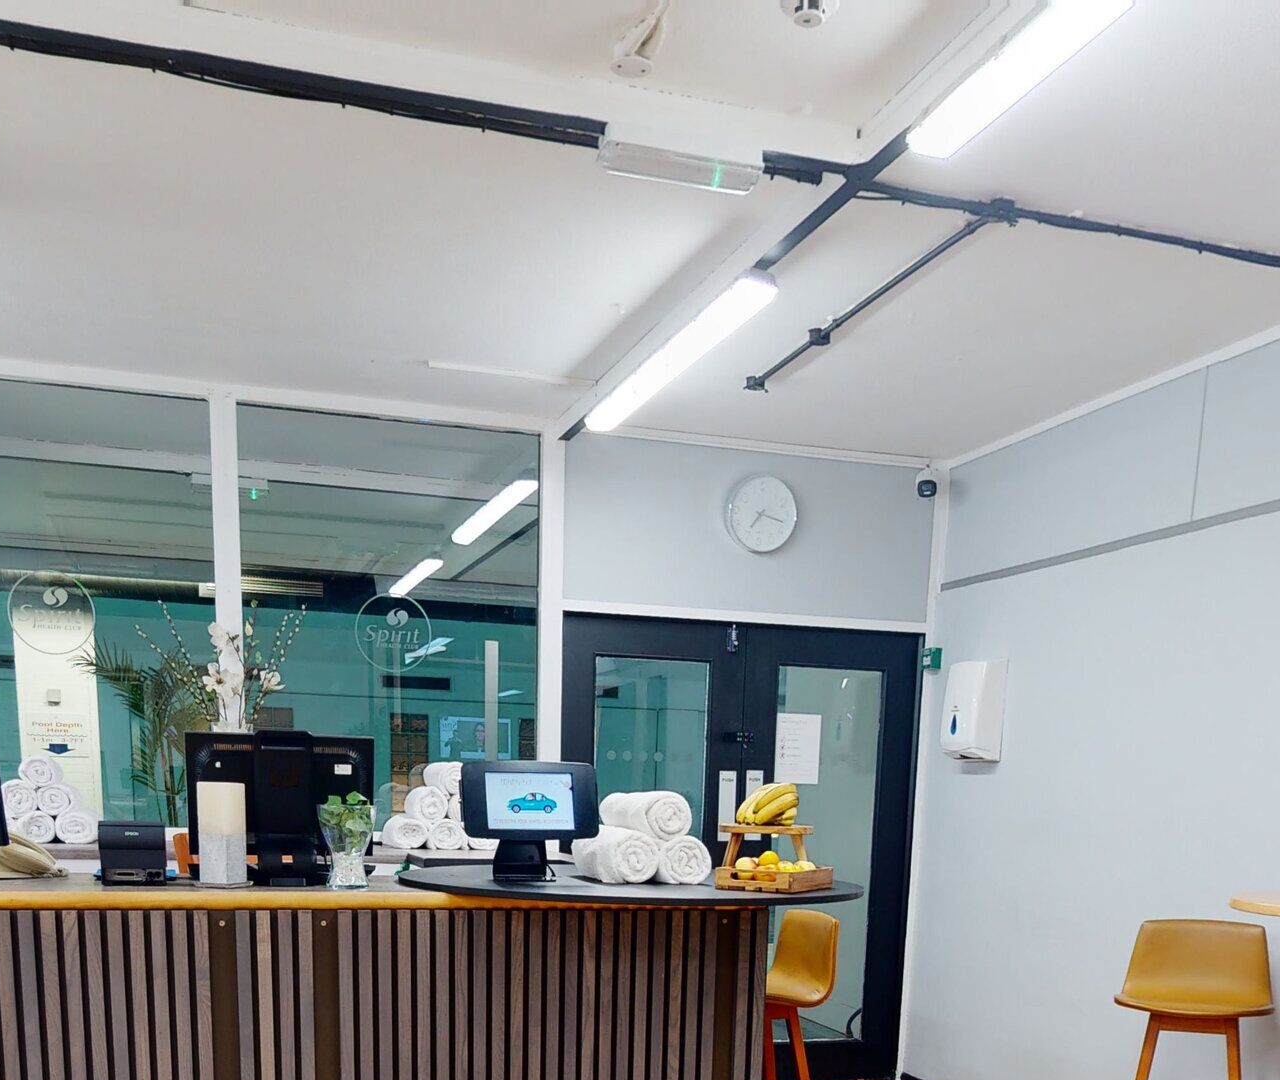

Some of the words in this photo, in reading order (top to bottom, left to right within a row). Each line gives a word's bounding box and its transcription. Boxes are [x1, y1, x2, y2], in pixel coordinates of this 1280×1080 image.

[17, 604, 82, 629] Spirit
[363, 624, 420, 648] Spirit
[55, 721, 83, 729] Depth
